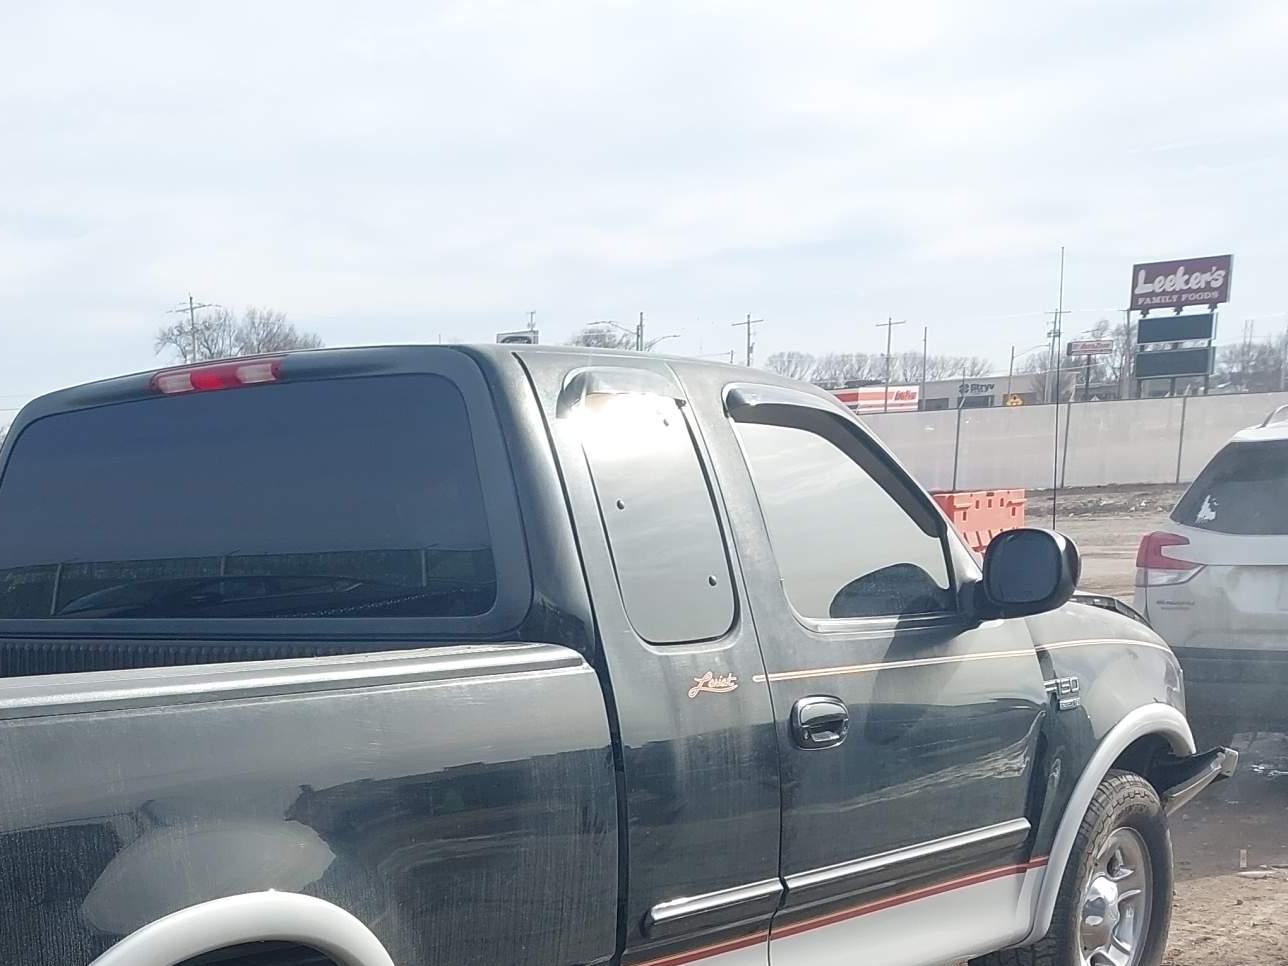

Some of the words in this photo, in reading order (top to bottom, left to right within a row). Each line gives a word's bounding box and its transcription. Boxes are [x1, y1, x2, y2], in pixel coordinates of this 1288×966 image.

[1134, 266, 1225, 294] Leeker's
[1138, 294, 1178, 304] FAMILY
[1181, 291, 1219, 301] FOODS
